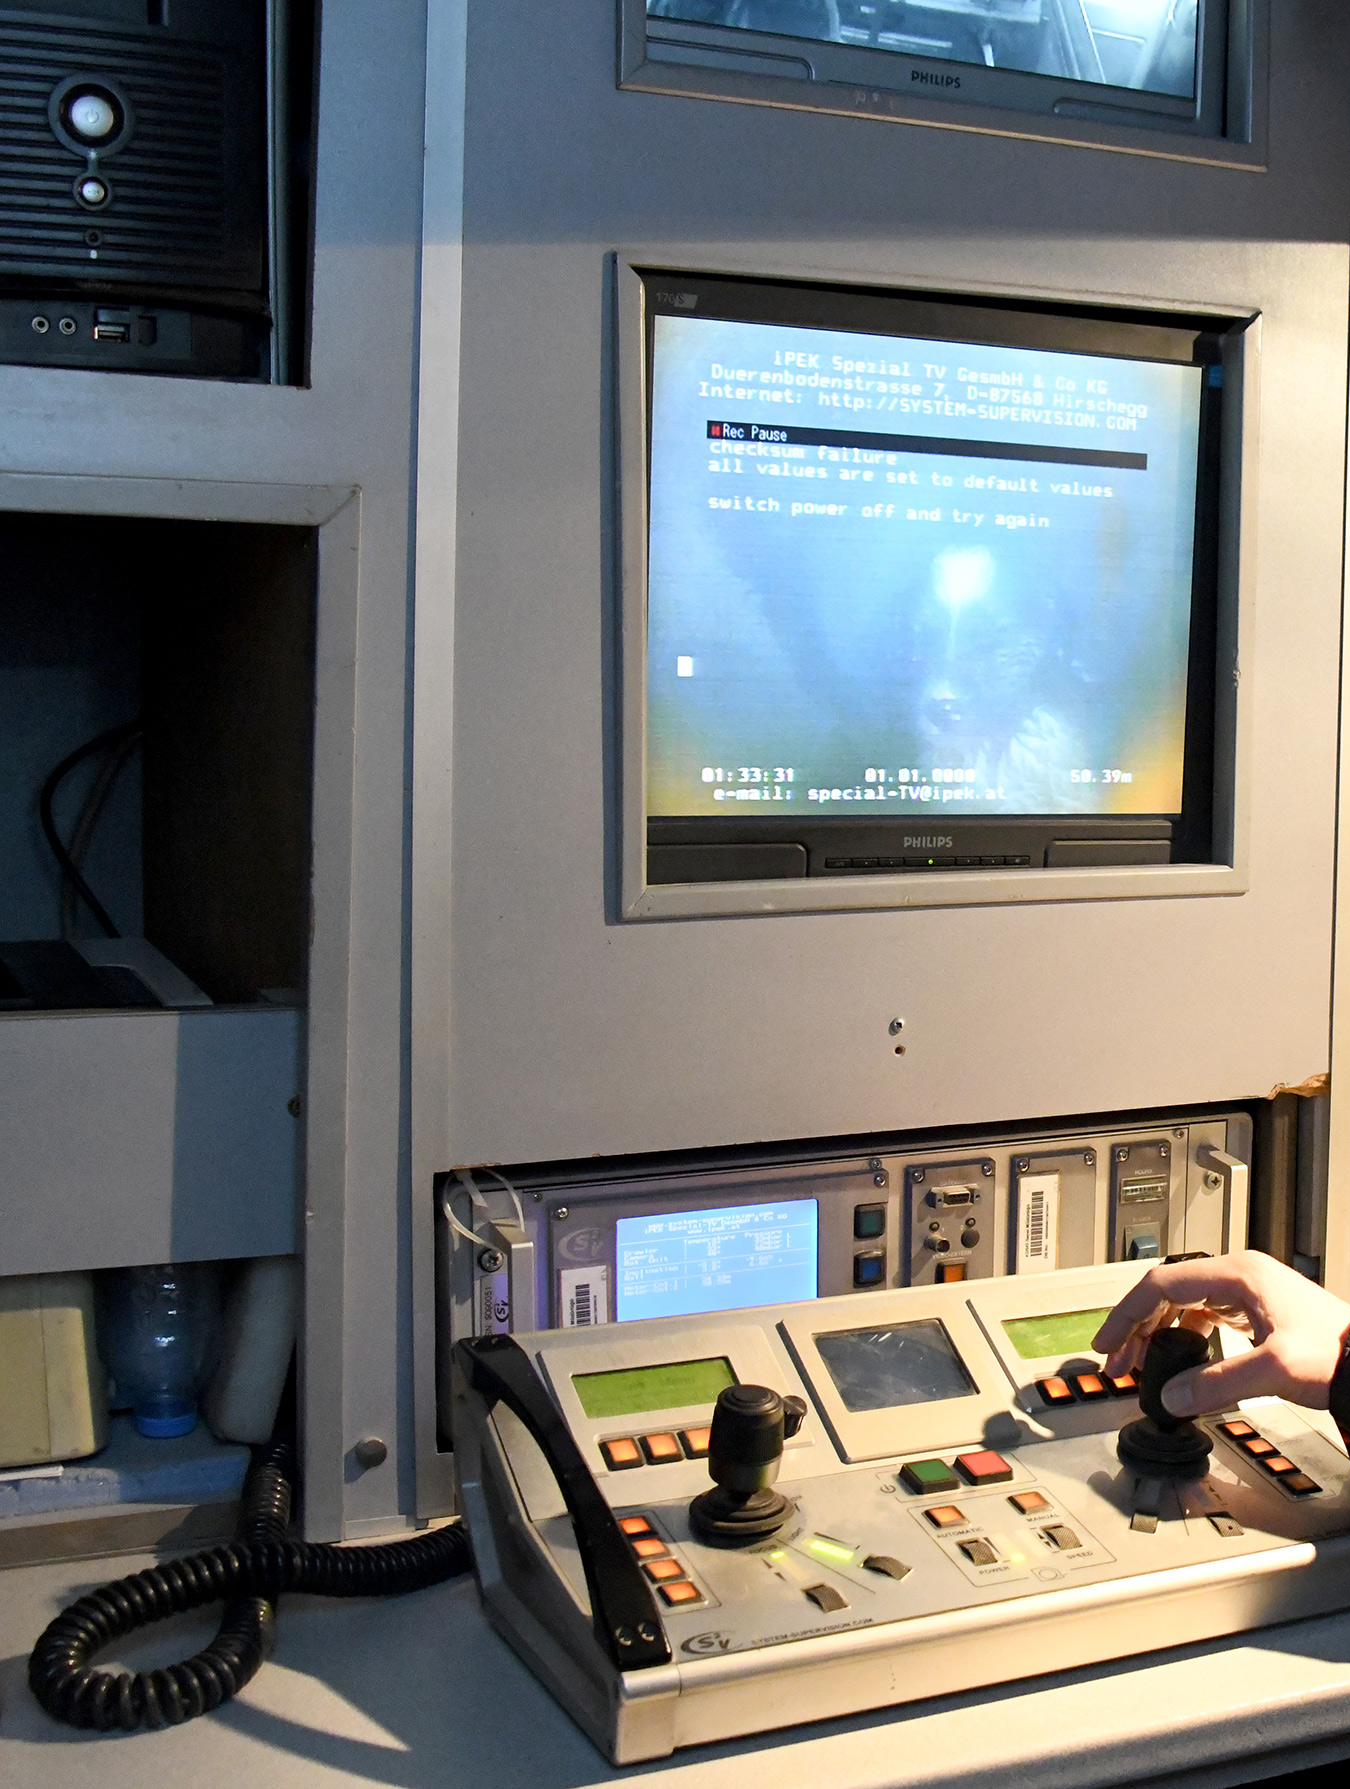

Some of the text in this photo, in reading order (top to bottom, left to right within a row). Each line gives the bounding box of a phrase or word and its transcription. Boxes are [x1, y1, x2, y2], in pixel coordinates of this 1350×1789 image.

[911, 70, 961, 89] PHILIPS
[774, 350, 820, 369] iPEK
[832, 356, 911, 376] Spezial
[923, 363, 946, 379] TV
[957, 367, 1023, 387] GesmbH
[1033, 374, 1046, 389] &
[1086, 379, 1107, 395] KG
[699, 381, 802, 404] Internet:
[711, 363, 922, 396] Duerenbodenstrasse
[1053, 394, 1148, 419] Hirschegg
[722, 423, 788, 442] Rec Pause
[709, 439, 897, 465] checksum failure
[708, 458, 1113, 498] all values are set to default values
[708, 496, 1050, 529] switch power off and try again
[701, 767, 794, 783] 01:33:31
[1070, 769, 1132, 784] 50.39m
[713, 785, 1007, 803] e-mail: special-TV@ipek.at
[903, 836, 953, 848] PHILIPS
[1026, 1513, 1060, 1522] MANUAL
[936, 1527, 984, 1539] AUTOMATIC
[1066, 1550, 1094, 1560] SPEED
[978, 1565, 1011, 1576] POWER
